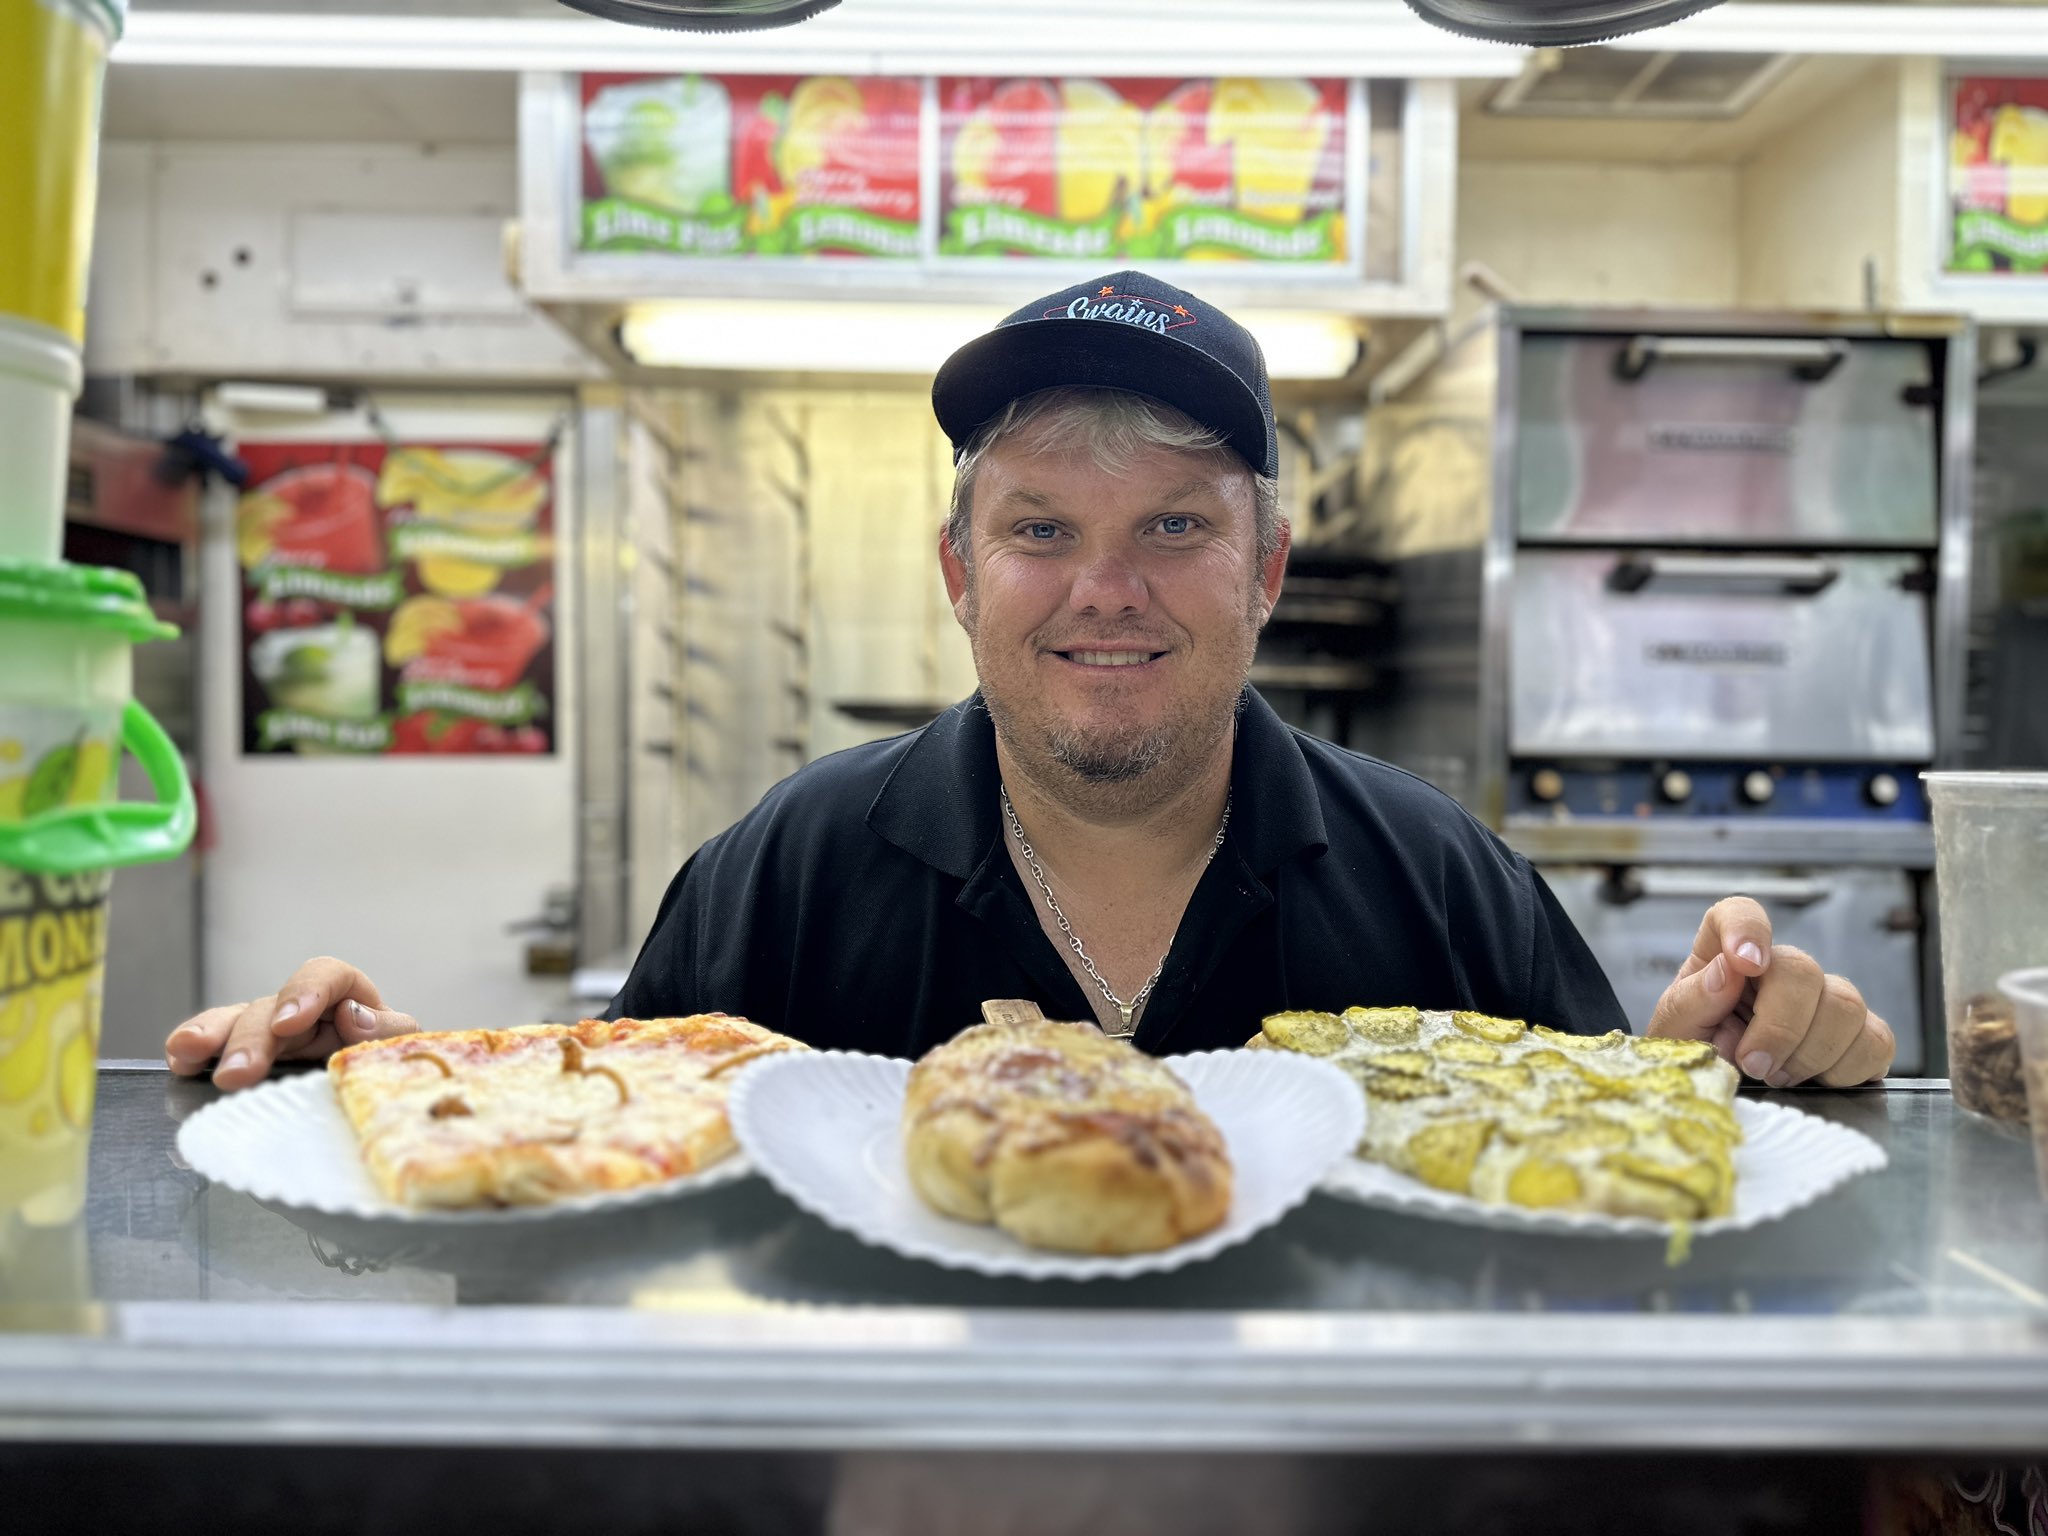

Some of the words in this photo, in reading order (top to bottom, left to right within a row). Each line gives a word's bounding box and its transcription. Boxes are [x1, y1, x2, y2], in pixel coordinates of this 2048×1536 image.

[799, 214, 921, 253] Lemona
[1066, 296, 1170, 334] Swains
[0, 909, 105, 986] MON
